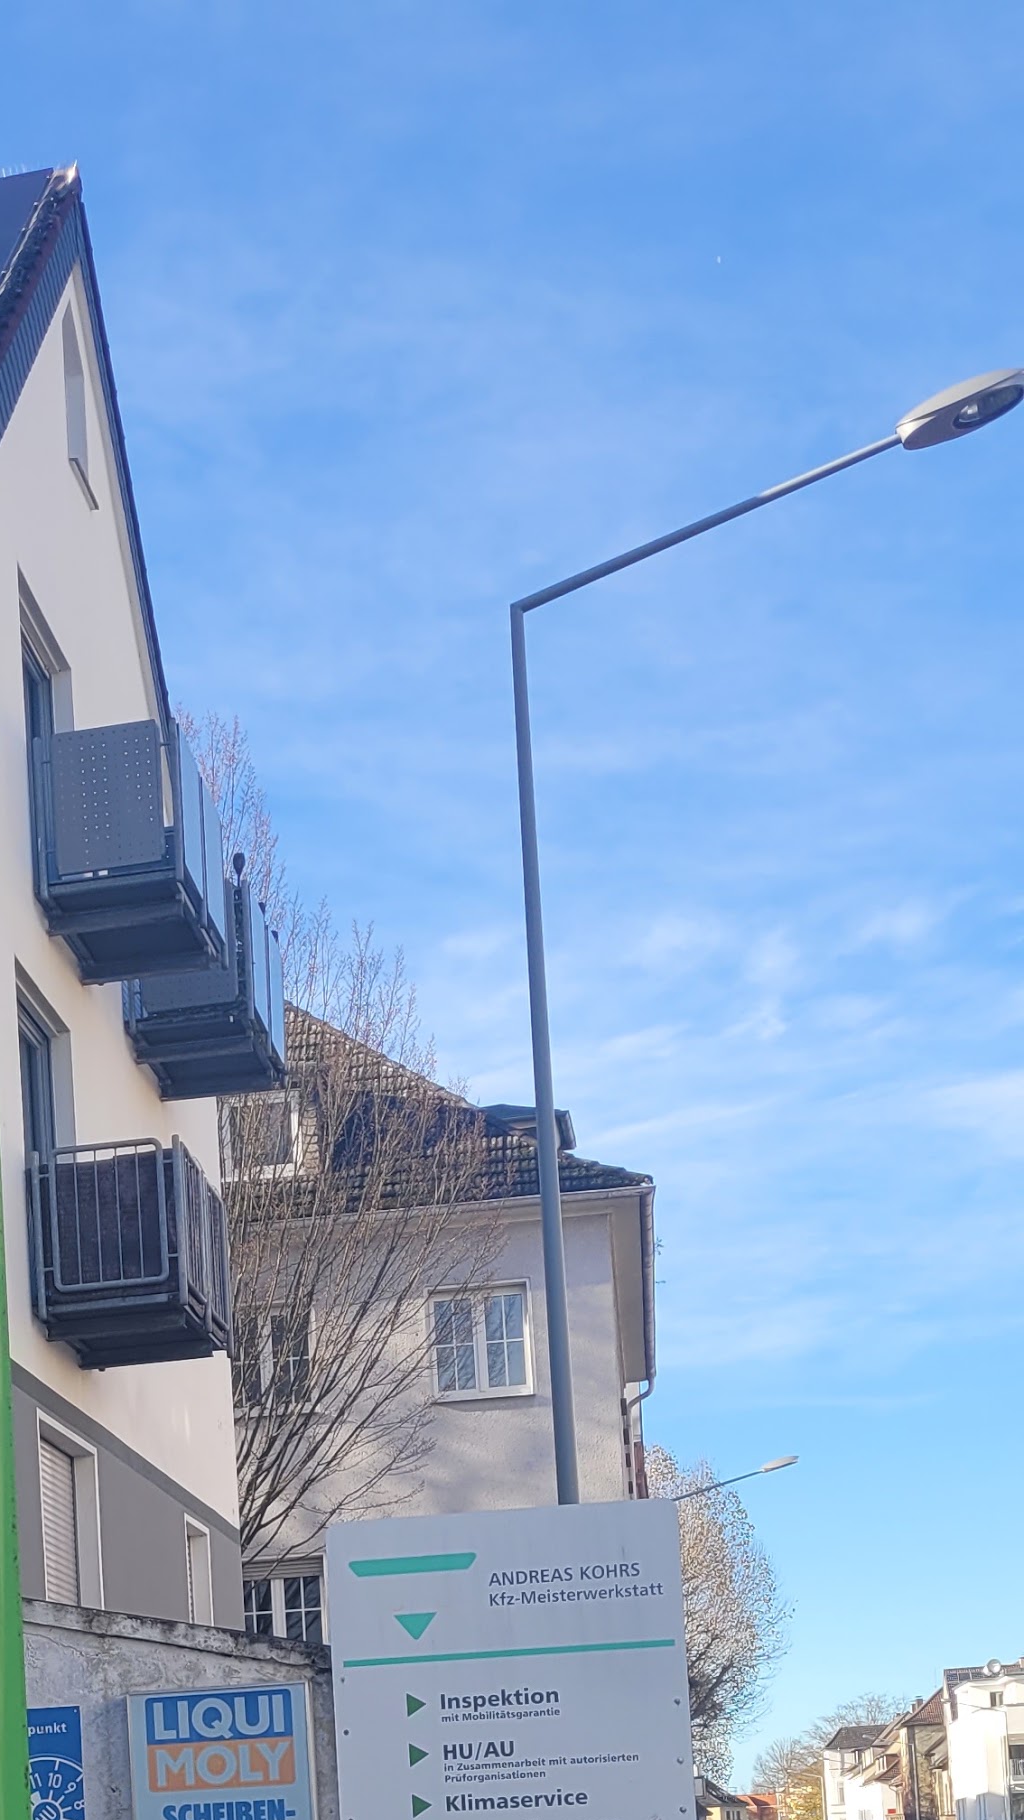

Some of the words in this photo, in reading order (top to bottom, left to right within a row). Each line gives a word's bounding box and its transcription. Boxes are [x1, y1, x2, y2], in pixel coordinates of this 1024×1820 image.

[488, 1566, 574, 1587] ANDREAS
[579, 1562, 640, 1581] KOHRS
[488, 1582, 664, 1607] Kfz-Meisterwerkstatt
[440, 1687, 560, 1712] Inspektion
[153, 1694, 285, 1740] LIQUI
[441, 1713, 459, 1723] mit
[462, 1707, 561, 1721] Mobilitätsgarantie
[27, 1722, 68, 1738] punkt
[443, 1740, 515, 1761] HU/AU
[156, 1742, 291, 1788] MOLY
[444, 1763, 454, 1772] in
[457, 1758, 546, 1772] Zusammenarbeit
[549, 1756, 567, 1766] mit
[570, 1753, 639, 1765] autorisierten
[48, 1773, 62, 1788] 10
[444, 1770, 546, 1784] Prüforganisationen
[445, 1789, 589, 1813] Klimaservice
